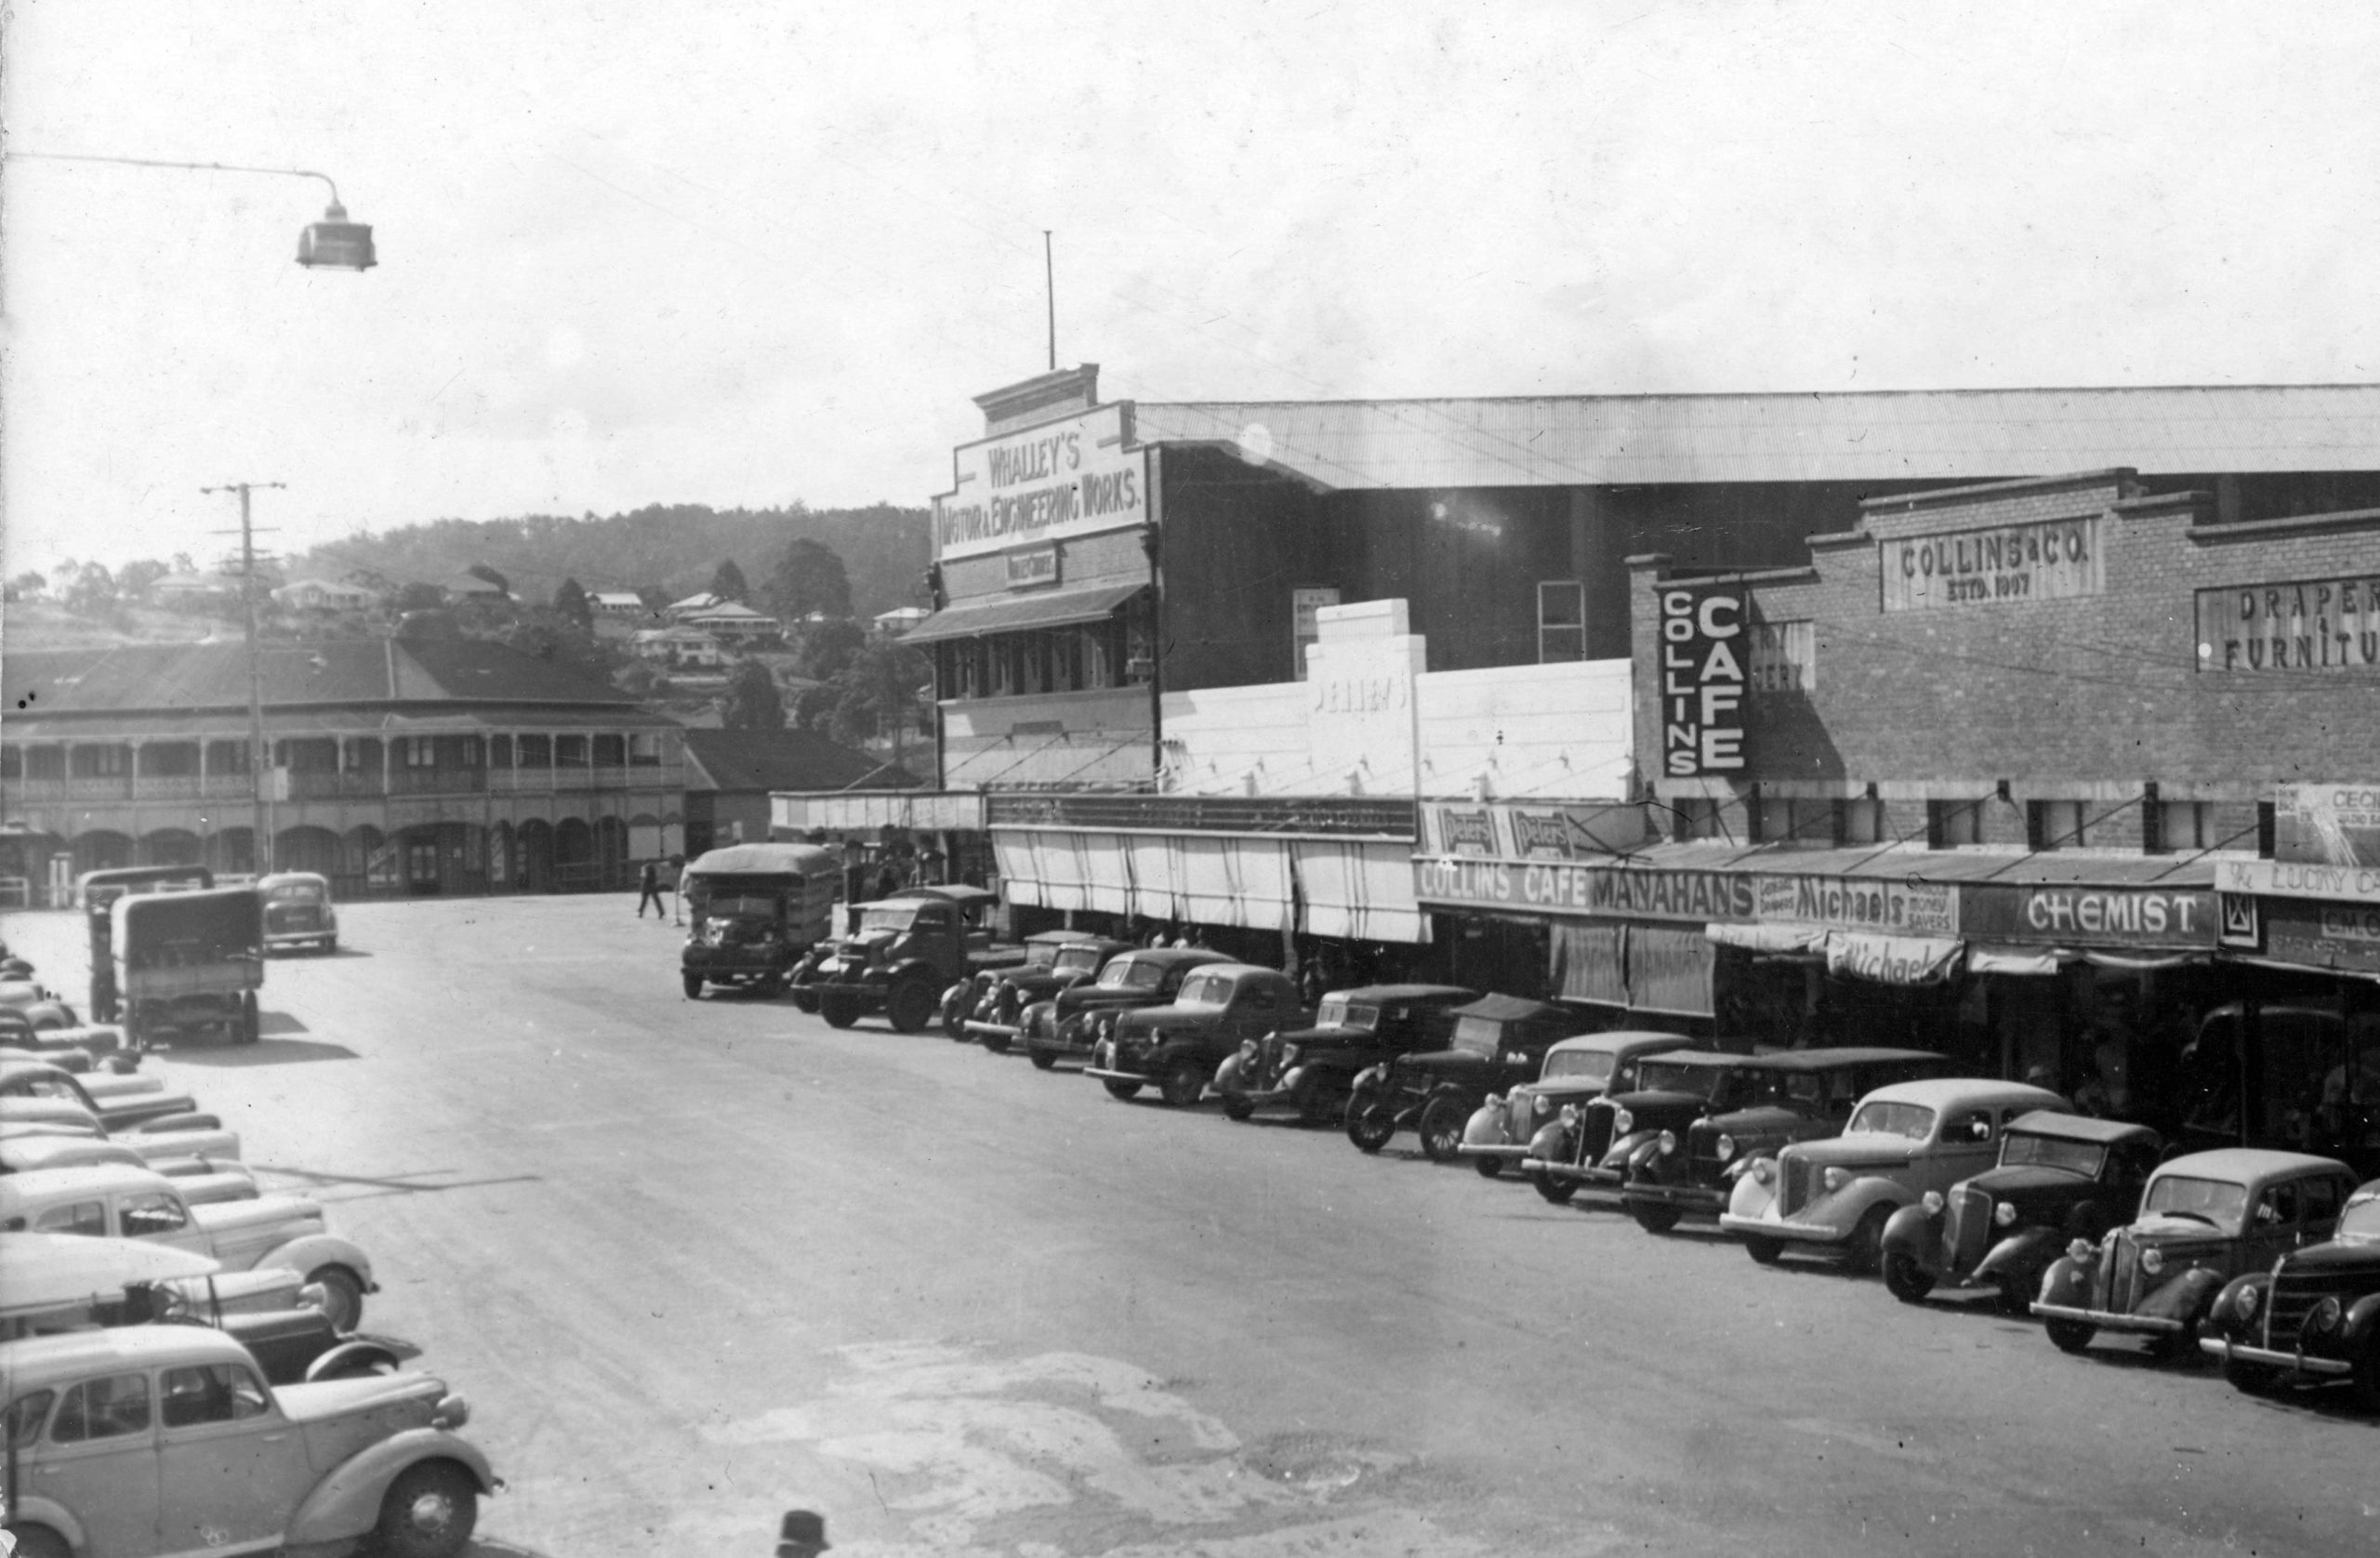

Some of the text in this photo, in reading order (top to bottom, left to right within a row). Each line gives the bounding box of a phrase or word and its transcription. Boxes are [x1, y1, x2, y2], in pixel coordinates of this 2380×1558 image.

[988, 431, 1081, 489] WHALLEY'S
[943, 504, 983, 546] MOTOR
[991, 482, 1079, 537] ENGINEERING
[1902, 535, 2023, 577] COLLINS
[1664, 591, 1698, 774] COLLINS
[1699, 597, 1745, 769] CAFE
[1421, 862, 1588, 906] COLLINS CAFE
[1593, 871, 1755, 917] MANAHANS
[1795, 876, 1905, 925] Michaels
[2272, 865, 2347, 892] LUCKY
